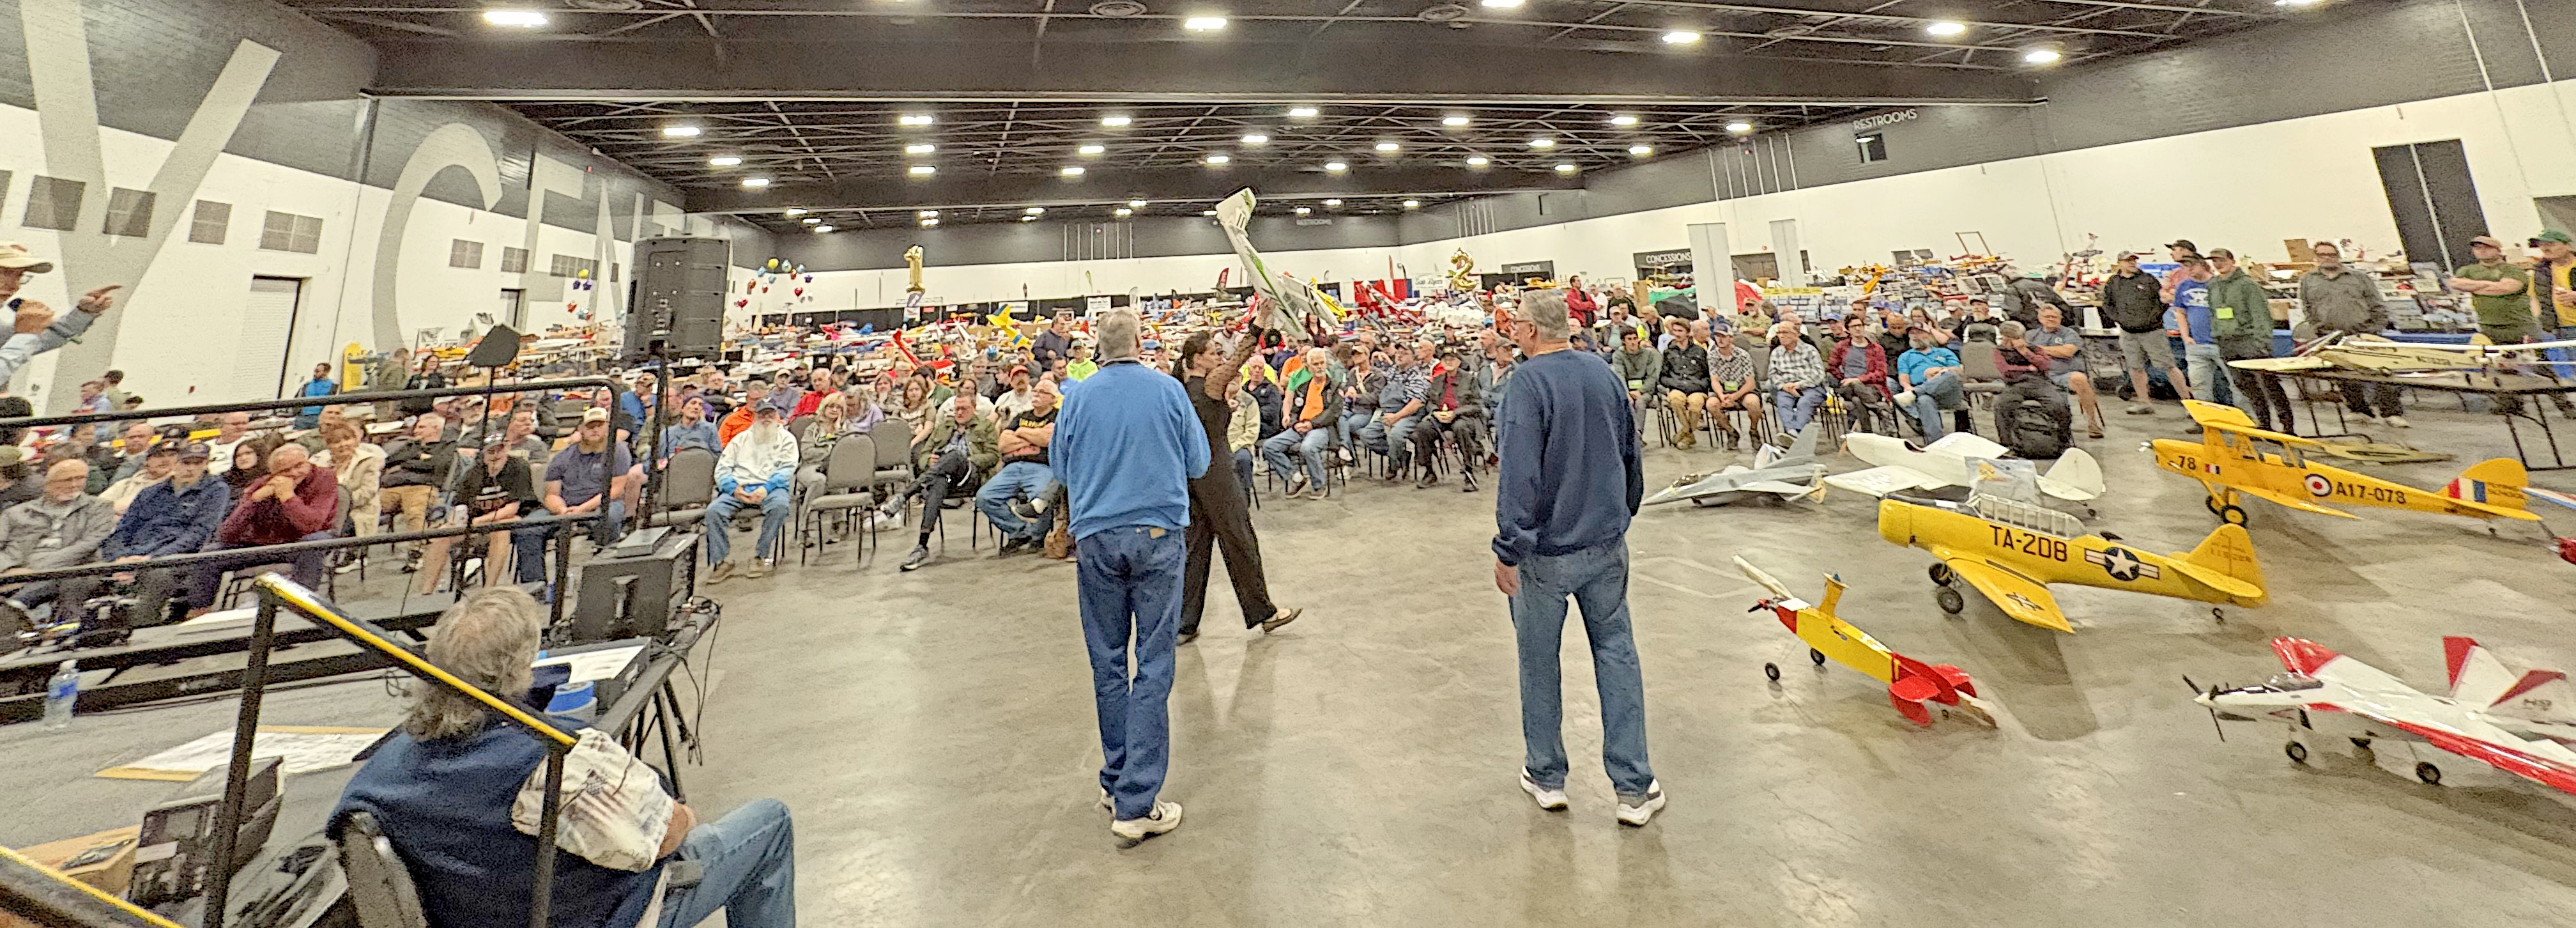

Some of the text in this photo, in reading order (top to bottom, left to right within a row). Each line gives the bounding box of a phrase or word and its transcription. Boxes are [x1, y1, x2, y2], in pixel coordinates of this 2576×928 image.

[1853, 108, 1917, 130] RESTROOMS
[1646, 252, 1692, 264] CONCESSIONS
[2178, 455, 2196, 470] 78
[2336, 481, 2406, 504] A17-078
[1989, 524, 2067, 562] TA-208
